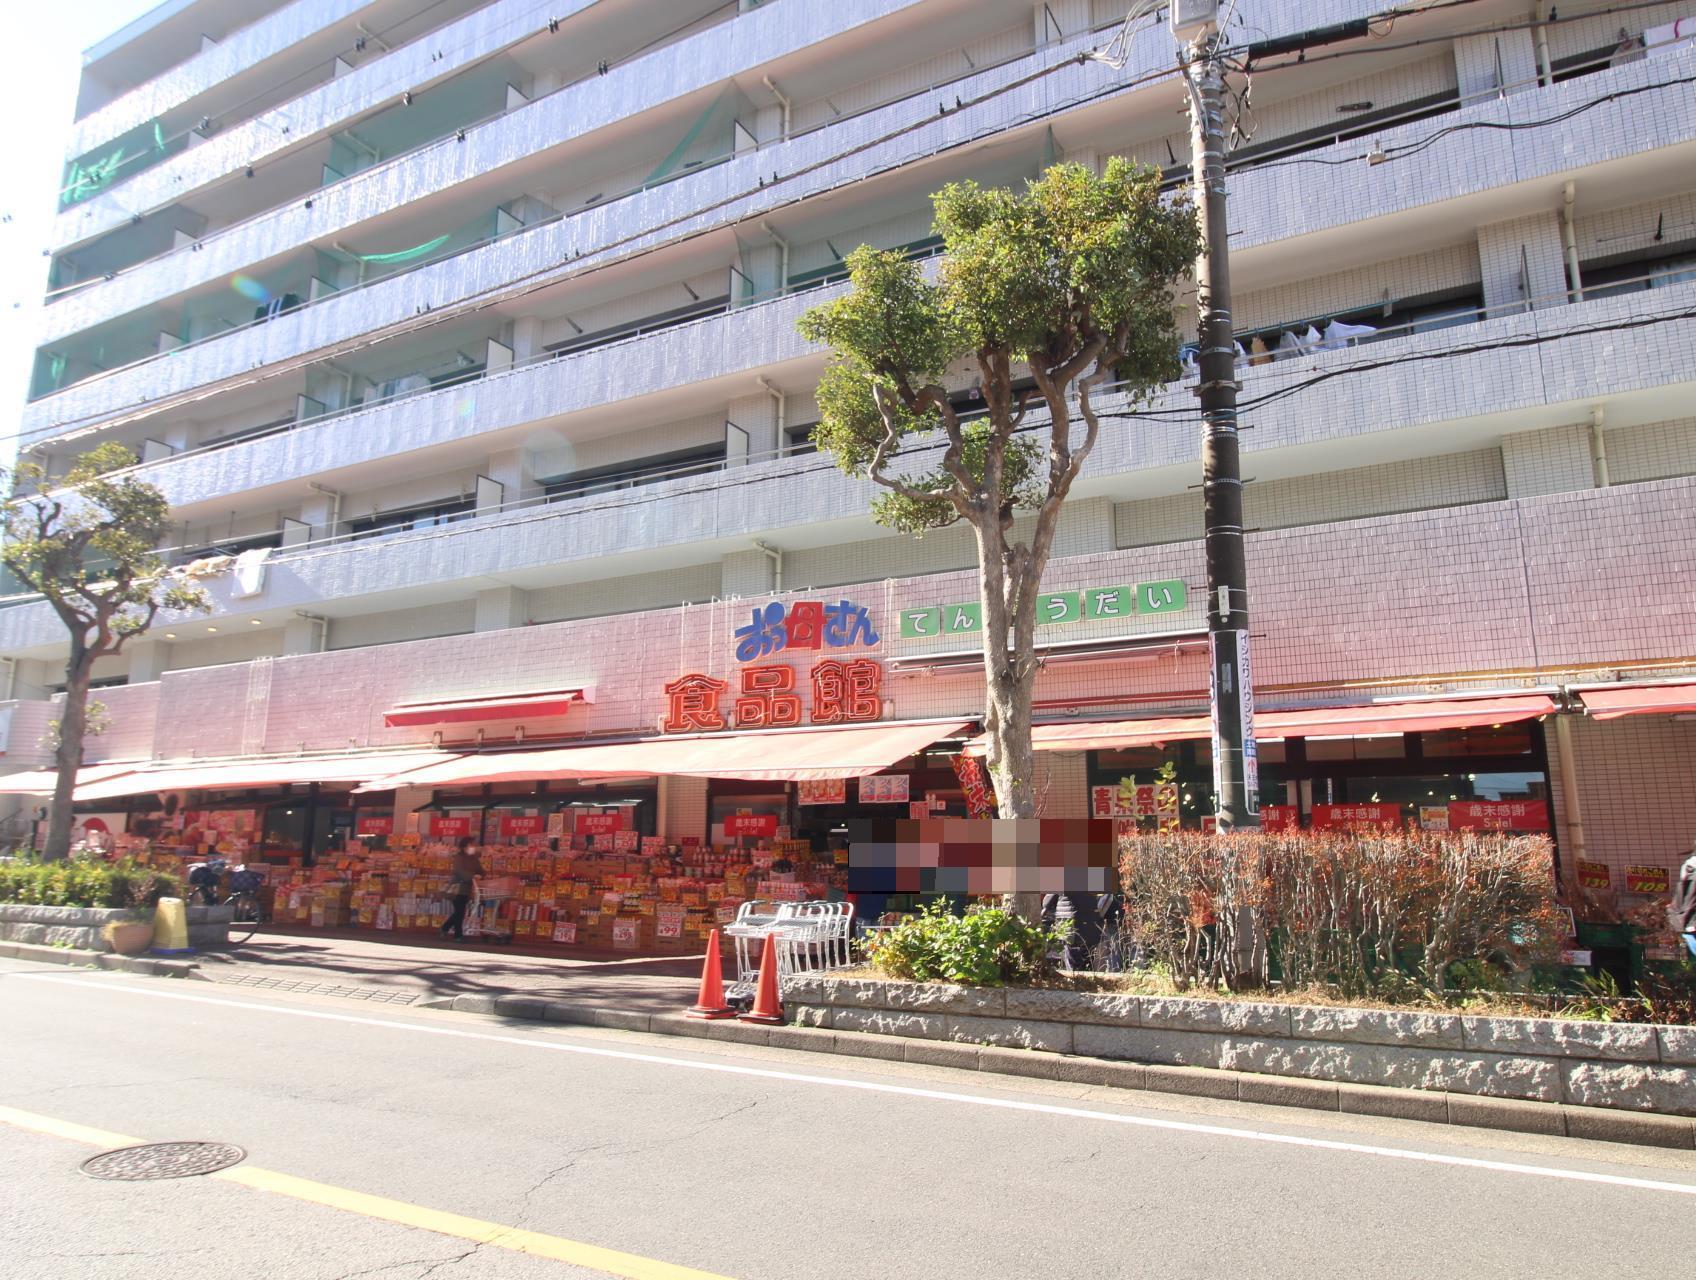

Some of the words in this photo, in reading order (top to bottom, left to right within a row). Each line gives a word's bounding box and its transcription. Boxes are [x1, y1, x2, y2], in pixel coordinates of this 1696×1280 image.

[908, 587, 1172, 633] てんうだい
[734, 600, 881, 663] お母さん
[664, 659, 882, 734] 食品館
[1330, 808, 1381, 820] 歳末感謝
[1469, 804, 1525, 817] 歳末感謝
[1634, 881, 1667, 892] 108
